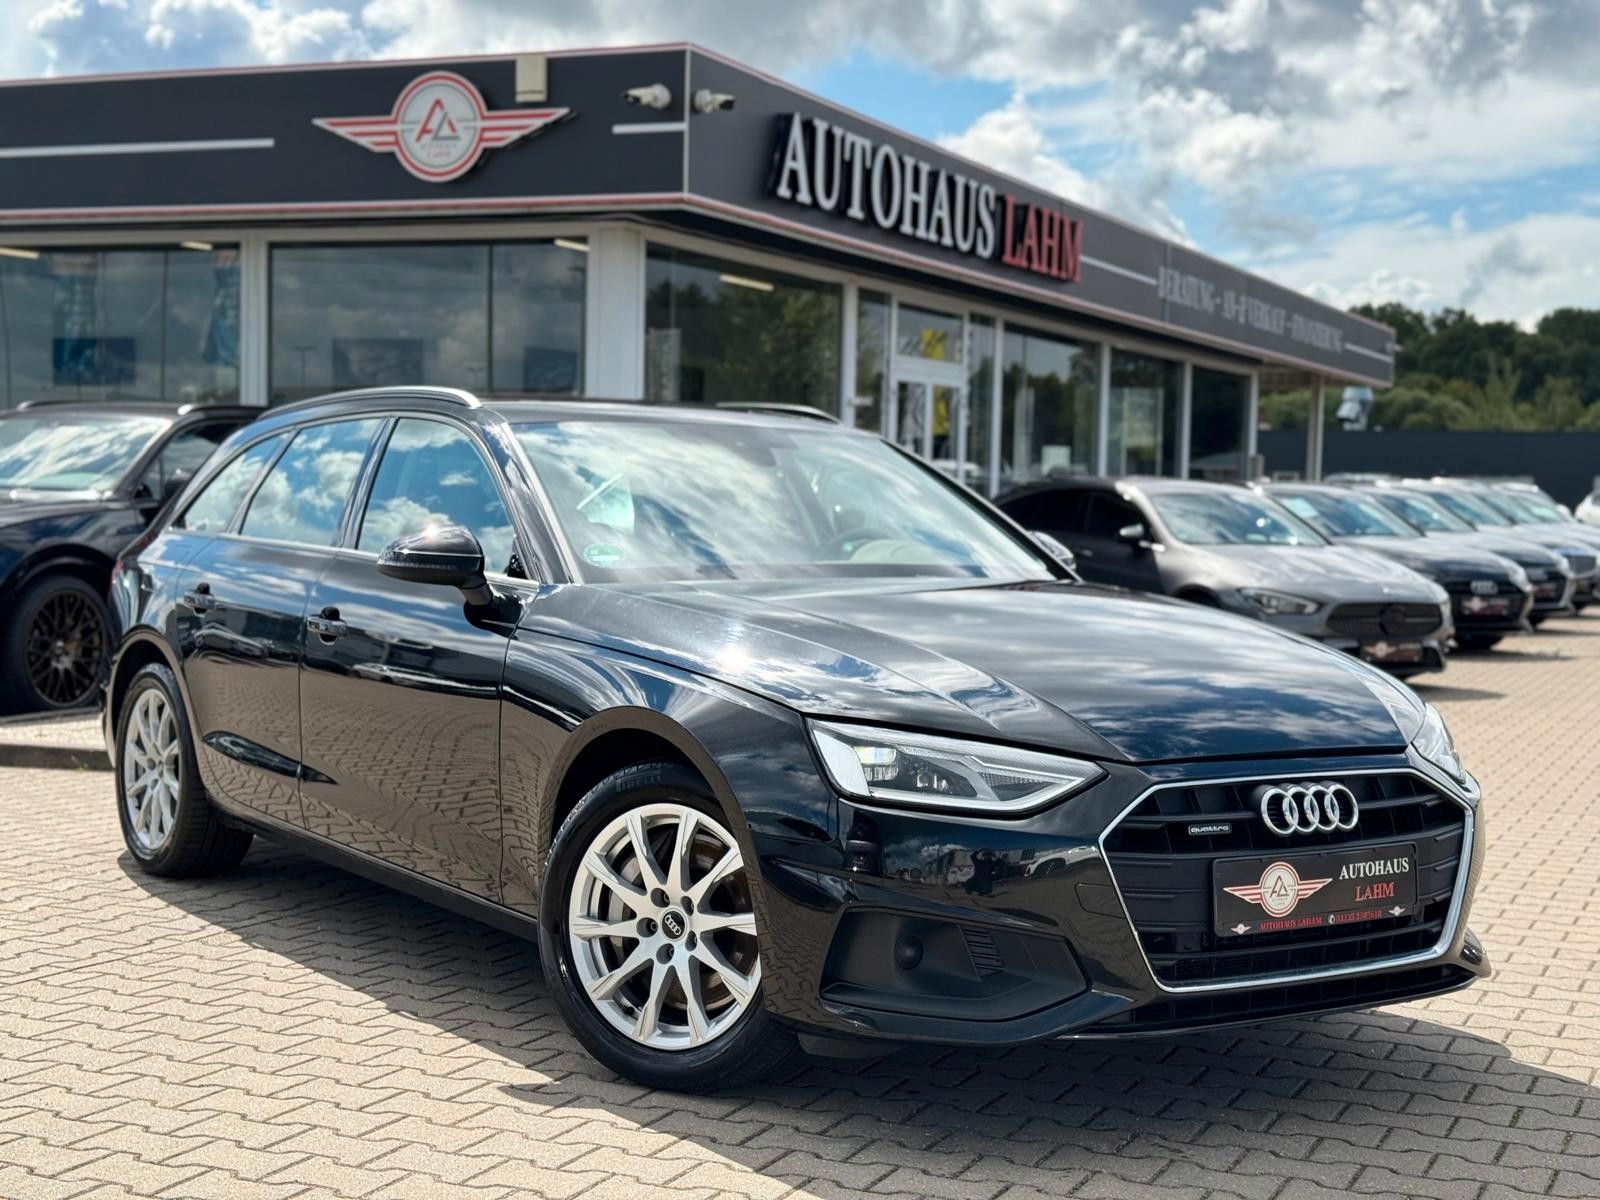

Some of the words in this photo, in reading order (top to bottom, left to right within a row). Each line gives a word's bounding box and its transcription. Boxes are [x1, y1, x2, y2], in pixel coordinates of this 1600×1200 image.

[776, 112, 996, 259] AUTOHAUS
[1002, 192, 1084, 284] LAHM
[1190, 825, 1229, 834] quattro
[1339, 857, 1409, 880] AUTOHAUS
[1354, 881, 1395, 902] LAHM
